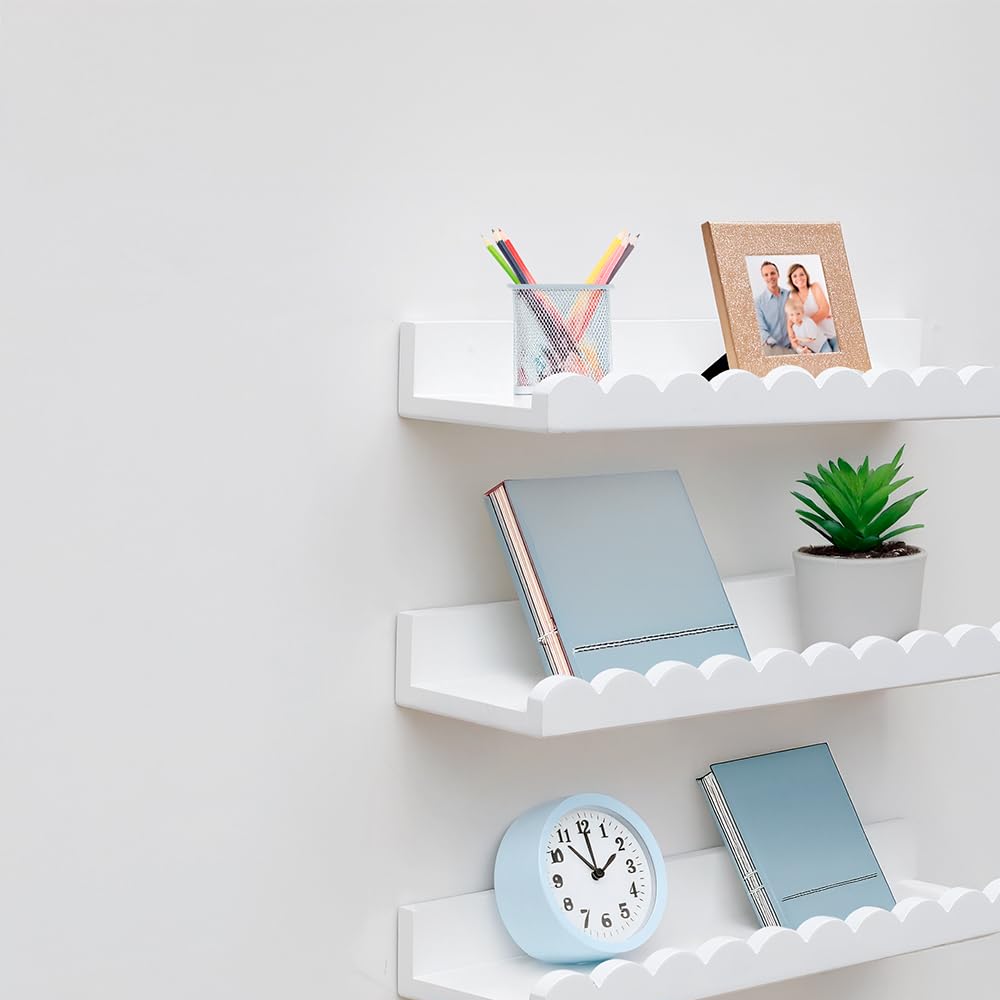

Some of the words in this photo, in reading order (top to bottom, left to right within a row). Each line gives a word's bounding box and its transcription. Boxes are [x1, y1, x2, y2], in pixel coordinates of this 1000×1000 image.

[575, 819, 591, 835] 12
[598, 823, 608, 838] 1
[557, 828, 571, 843] 11
[615, 837, 625, 851] 2
[551, 848, 564, 864] 10
[626, 859, 636, 873] 3
[553, 874, 563, 888] 9
[629, 881, 640, 897] 4
[563, 898, 573, 911] 8
[619, 903, 630, 918] 5
[580, 909, 590, 928] 7
[602, 913, 612, 927] 6
